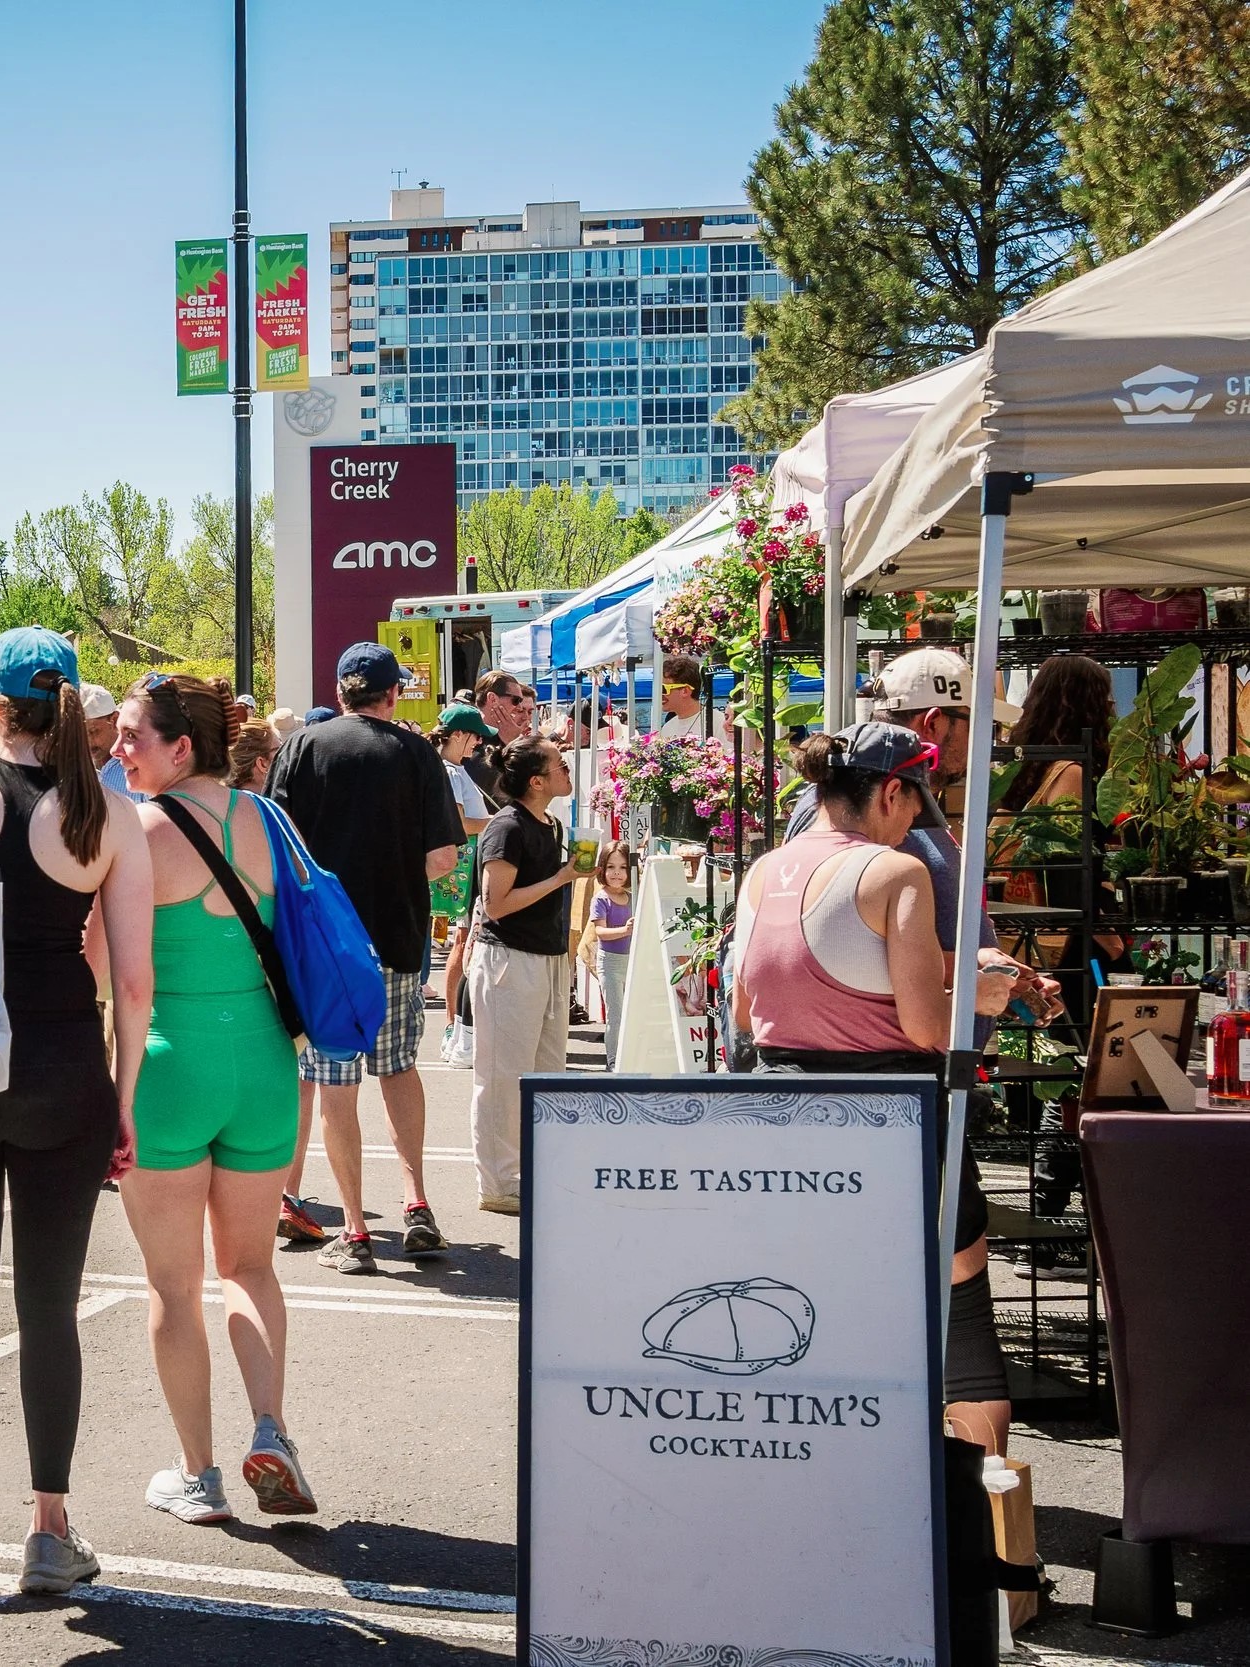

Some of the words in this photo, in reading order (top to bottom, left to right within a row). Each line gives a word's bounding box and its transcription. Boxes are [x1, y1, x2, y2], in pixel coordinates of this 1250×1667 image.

[187, 294, 218, 307] GET
[263, 299, 300, 309] FRESH
[178, 306, 226, 318] FRESH
[257, 307, 306, 318] MARKET
[262, 317, 302, 325] SATURDAYS
[278, 323, 295, 331] 9AM
[204, 330, 221, 338] 2PM
[189, 349, 217, 361] COLORADO
[268, 348, 297, 360] COLORADO
[189, 356, 217, 371] FRESH
[268, 354, 297, 370] FRESH
[189, 365, 217, 378] MARKETS
[268, 363, 297, 376] MARKETS
[330, 457, 399, 481] Cherry
[330, 478, 390, 500] Creek
[594, 1167, 679, 1191] FREE
[690, 1168, 863, 1195] TASTINGS
[582, 1385, 746, 1423] UNCLE
[754, 1391, 882, 1428] TIM'S
[649, 1434, 812, 1462] COCKTAILS
[184, 1482, 206, 1497] HOKA
